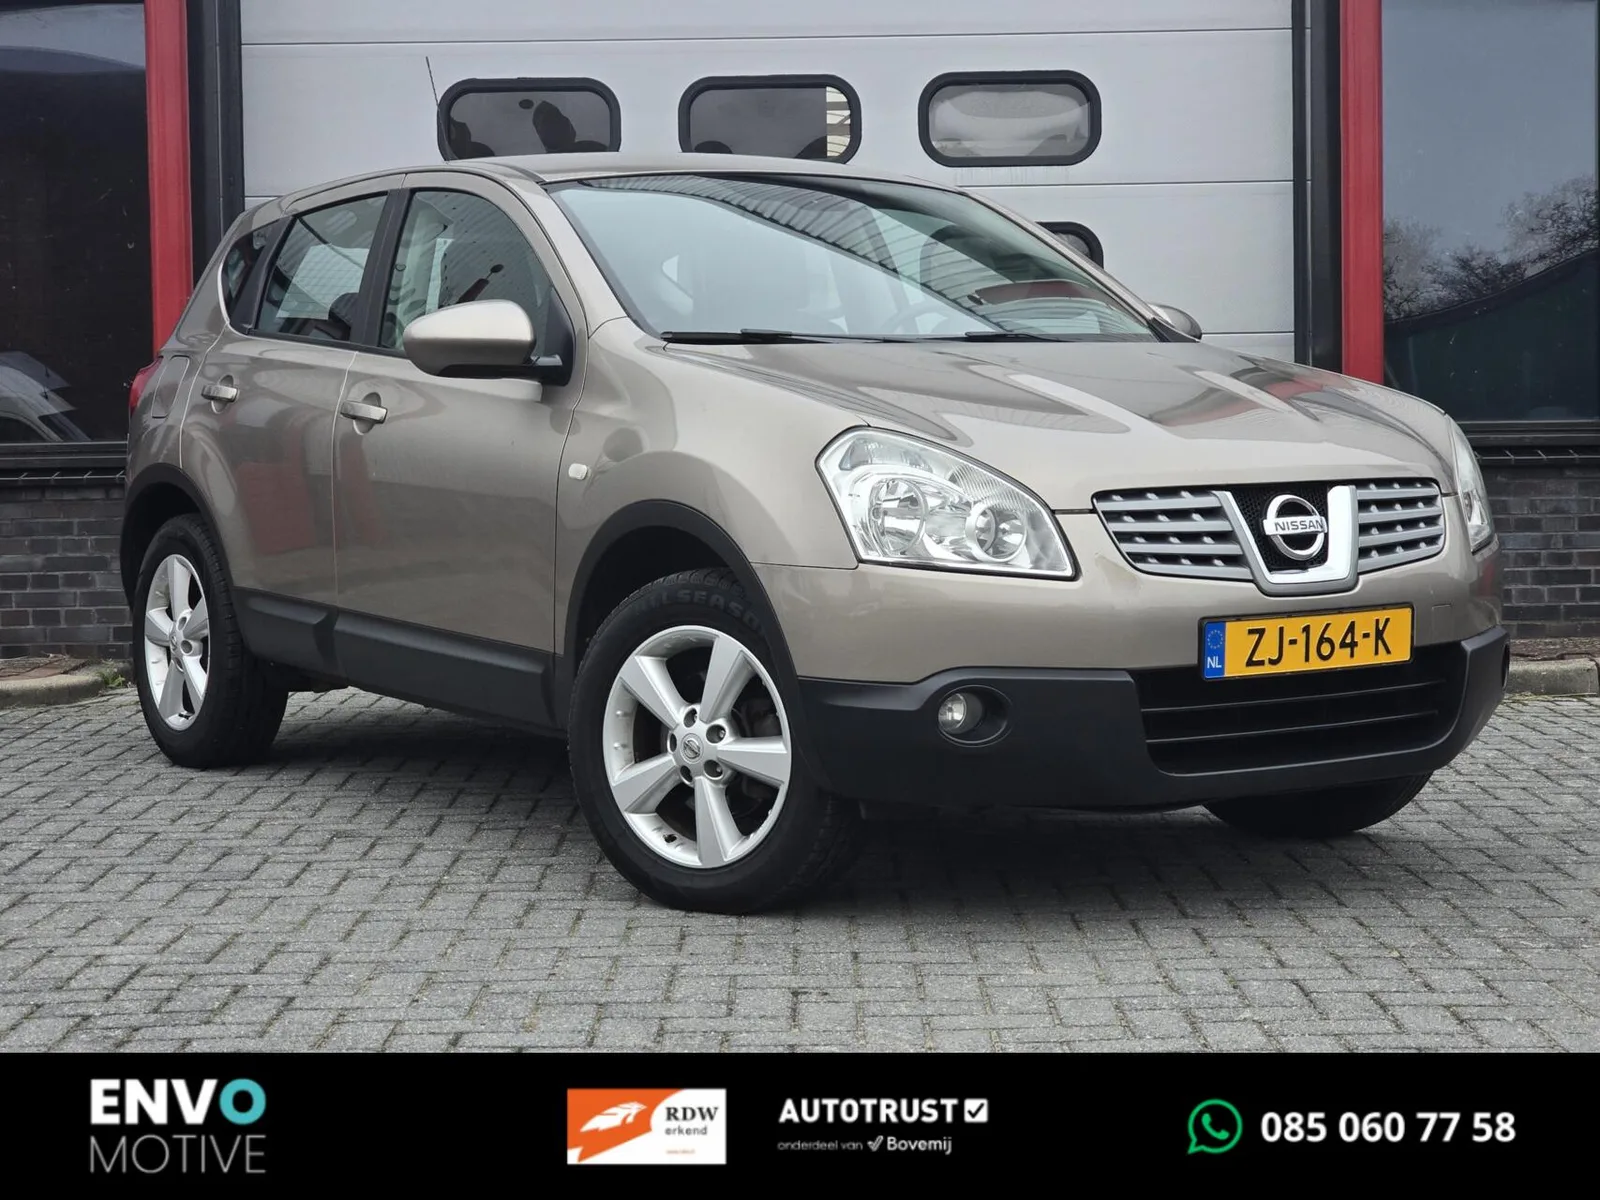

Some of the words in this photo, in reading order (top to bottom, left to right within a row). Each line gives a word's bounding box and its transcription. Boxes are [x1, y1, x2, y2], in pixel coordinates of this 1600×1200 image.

[1274, 520, 1325, 531] NISSAN
[1245, 617, 1392, 668] ZJ-164-K
[1206, 655, 1223, 669] NL
